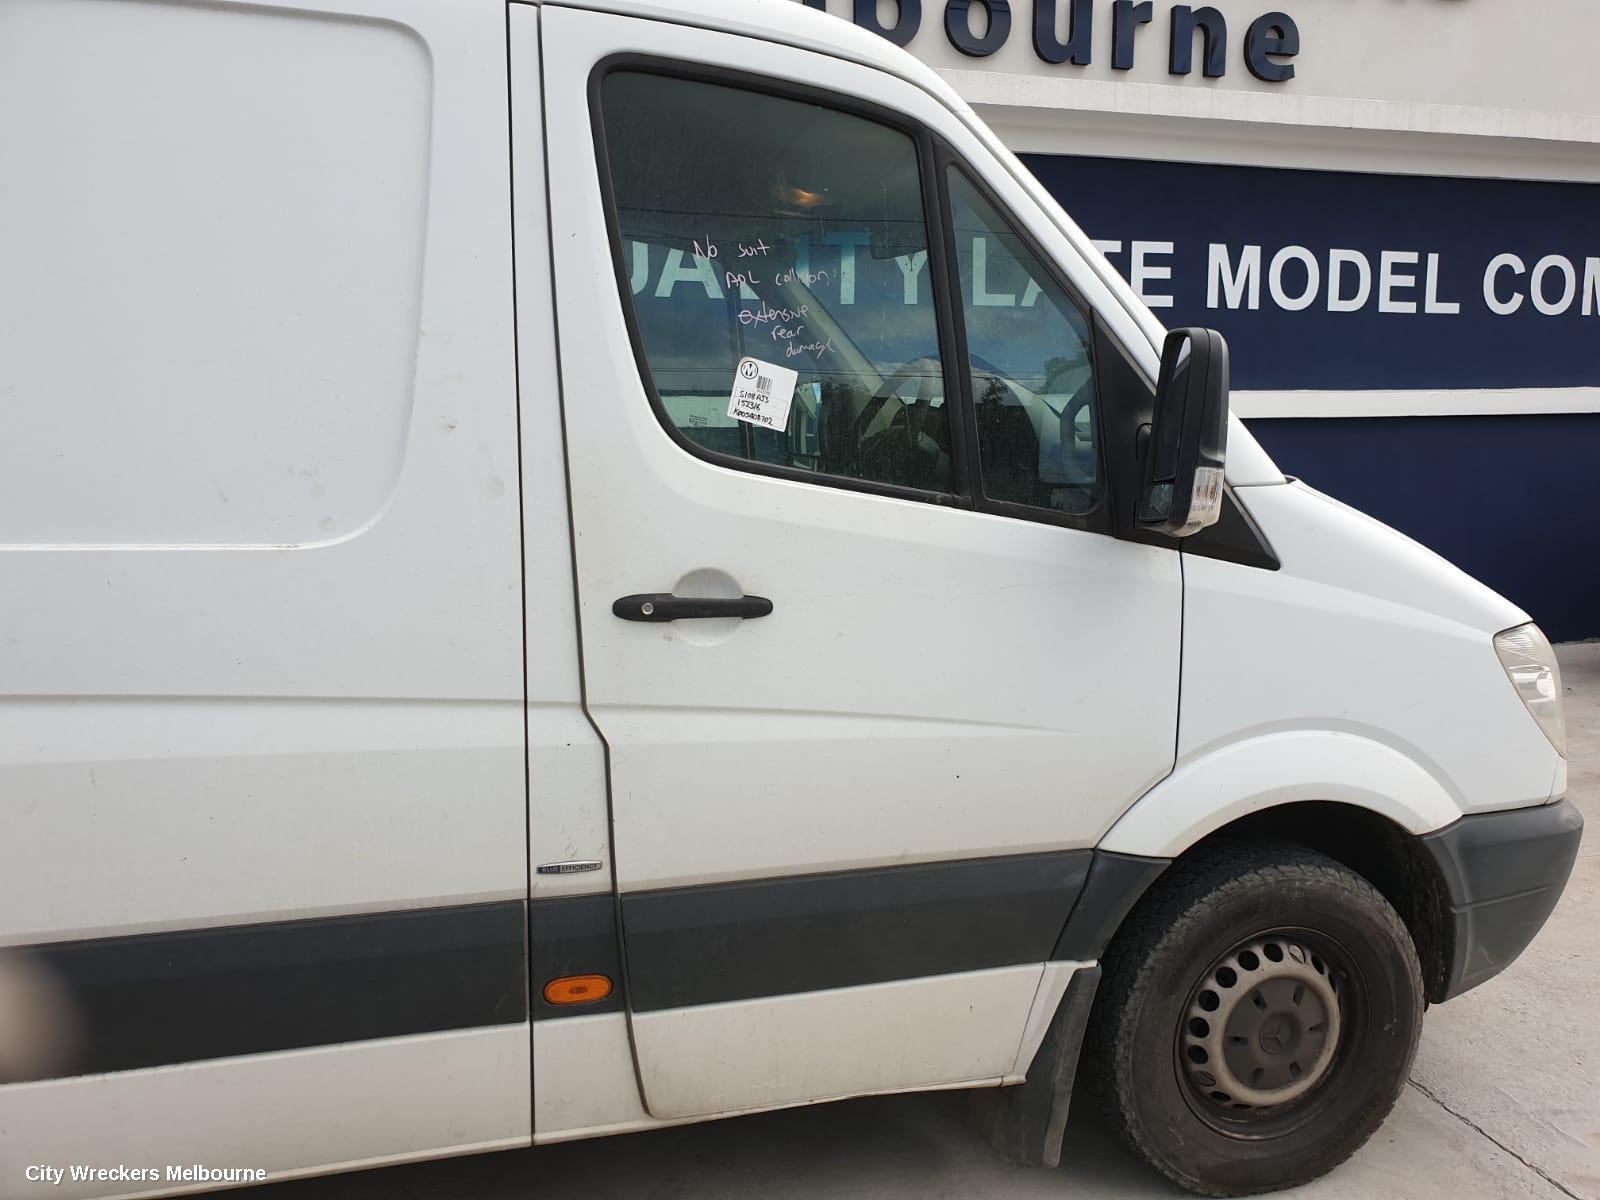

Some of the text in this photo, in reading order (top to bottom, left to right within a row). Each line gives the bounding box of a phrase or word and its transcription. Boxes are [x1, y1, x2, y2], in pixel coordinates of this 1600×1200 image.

[805, 0, 1300, 82] bourne
[693, 233, 770, 259] No suit
[973, 238, 1174, 307] LE
[1207, 243, 1460, 315] MODEL
[738, 300, 808, 328] extensive
[771, 325, 804, 340] rear
[561, 864, 597, 872] EFFICIENCY
